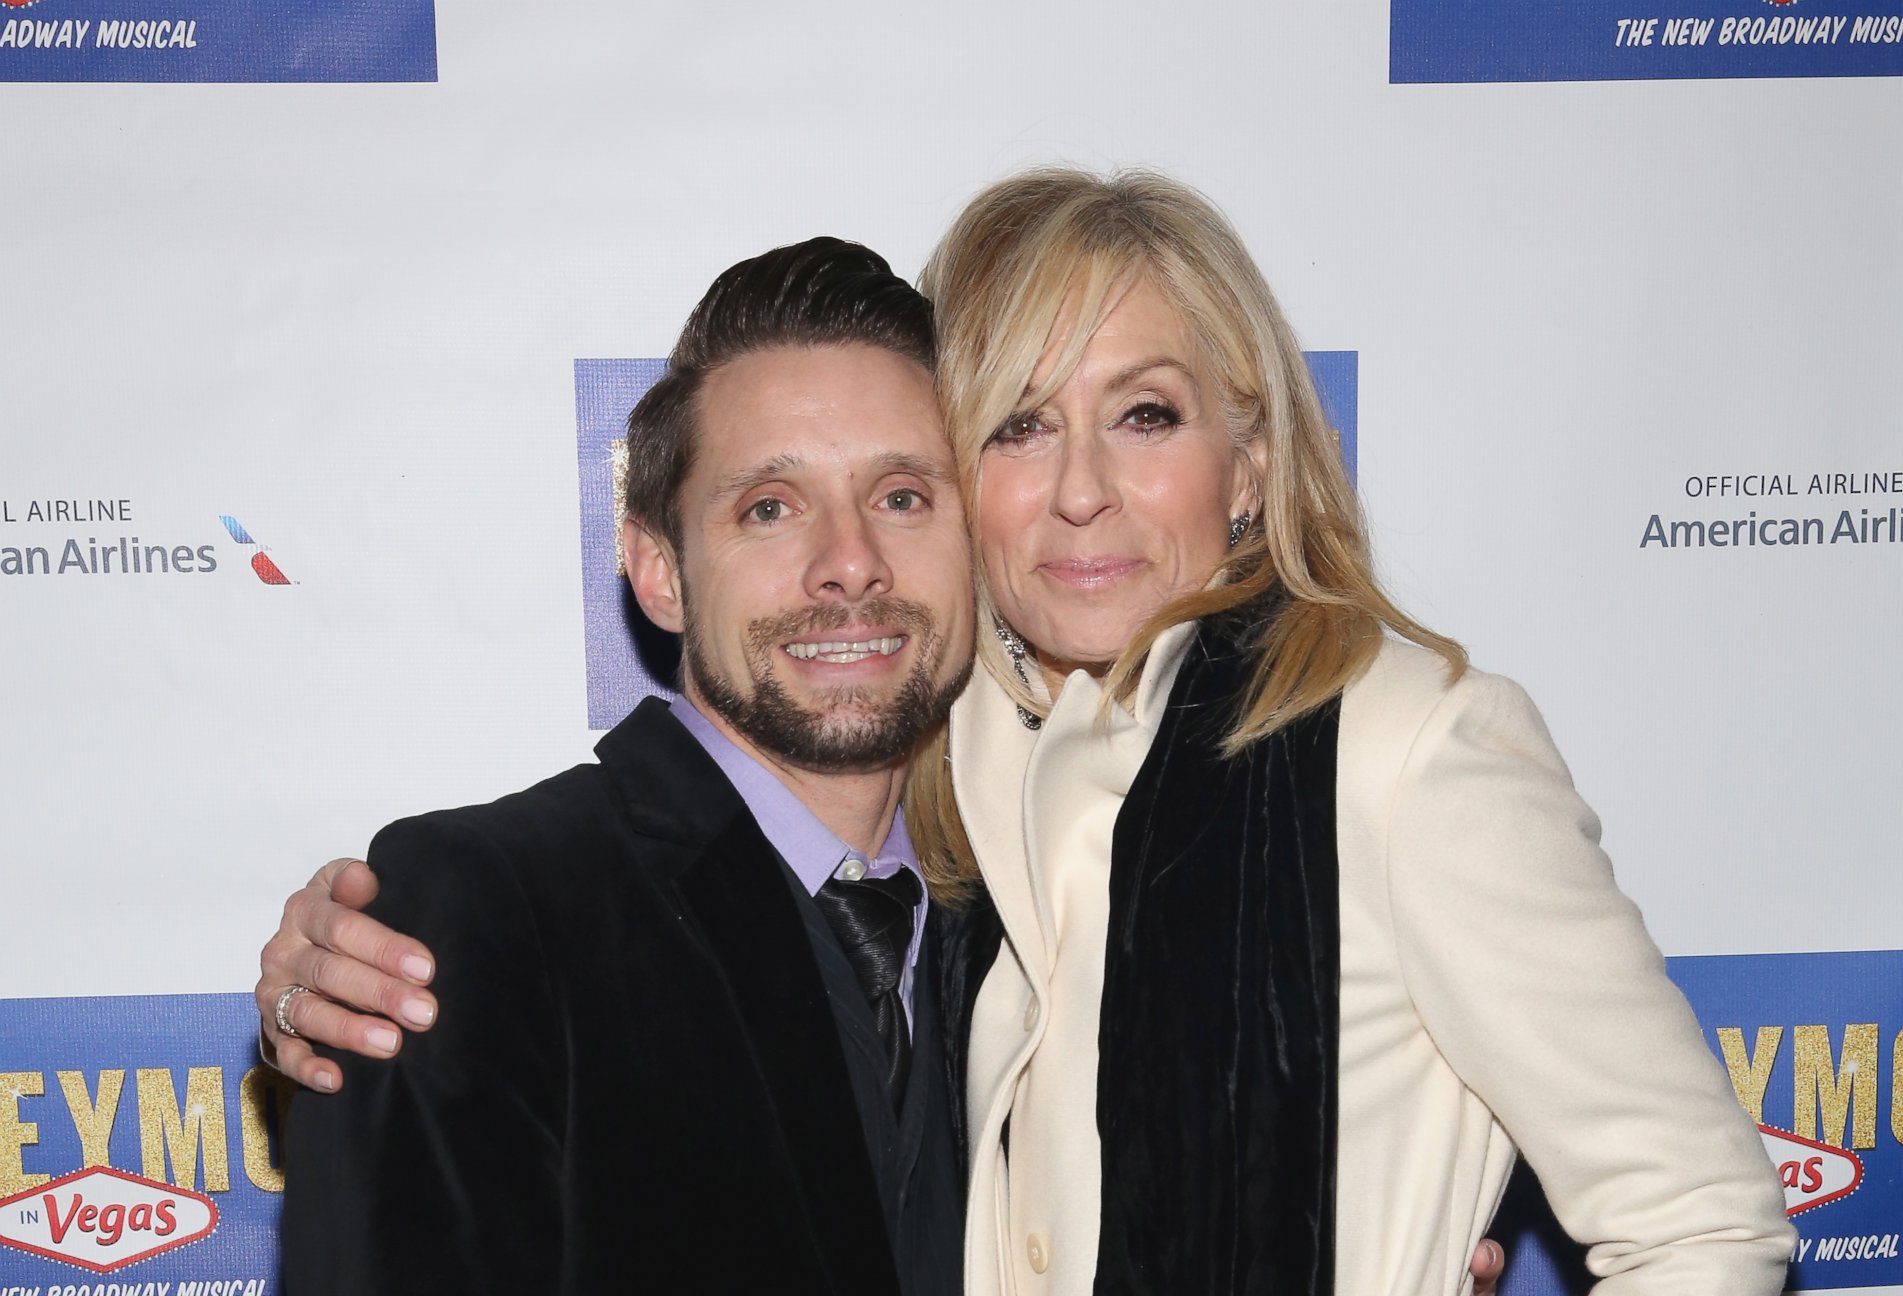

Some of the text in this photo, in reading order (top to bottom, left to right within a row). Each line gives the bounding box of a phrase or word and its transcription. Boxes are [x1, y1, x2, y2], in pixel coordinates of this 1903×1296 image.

[0, 19, 196, 48] ADWAY MUSICAL
[1616, 18, 1658, 46] THE
[1662, 18, 1714, 46] NEW
[1718, 15, 1846, 45] BROADWAY
[1685, 473, 1903, 497] OFFICIAL AIRLINE
[27, 500, 132, 522] AIRLINE
[1640, 512, 1824, 548] American
[57, 537, 217, 574] Airlines
[20, 1193, 177, 1245] IN Vegas
[1814, 1234, 1899, 1262] MUSICAL
